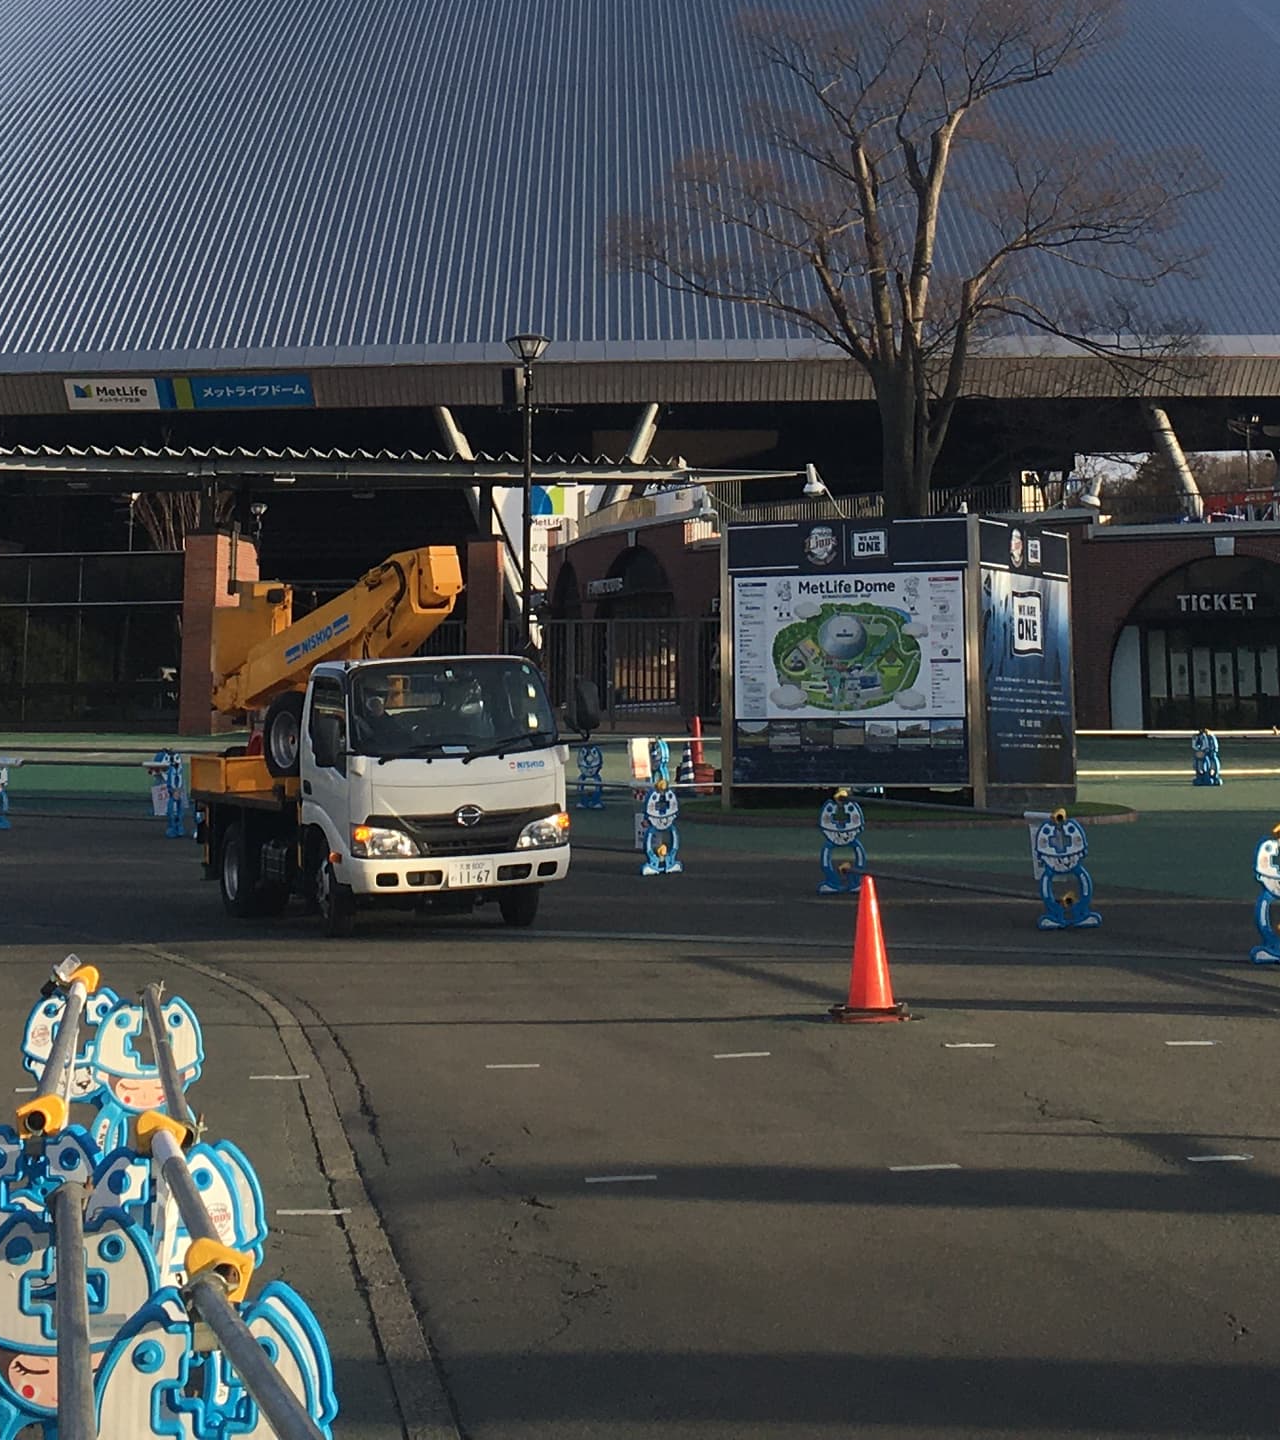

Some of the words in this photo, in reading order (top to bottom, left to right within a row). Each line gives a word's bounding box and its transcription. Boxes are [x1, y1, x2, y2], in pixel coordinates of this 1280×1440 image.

[95, 385, 148, 398] MetLife
[202, 383, 306, 398] メットライフドーム
[858, 541, 881, 553] ONE
[799, 580, 852, 595] MetLife
[854, 579, 896, 593] Dome
[1176, 592, 1257, 612] TICKET
[1026, 605, 1036, 617] ARE
[1017, 618, 1038, 642] ONE
[301, 625, 334, 656] NISHIO
[516, 760, 545, 770] NISHIO
[208, 1210, 232, 1225] ions
